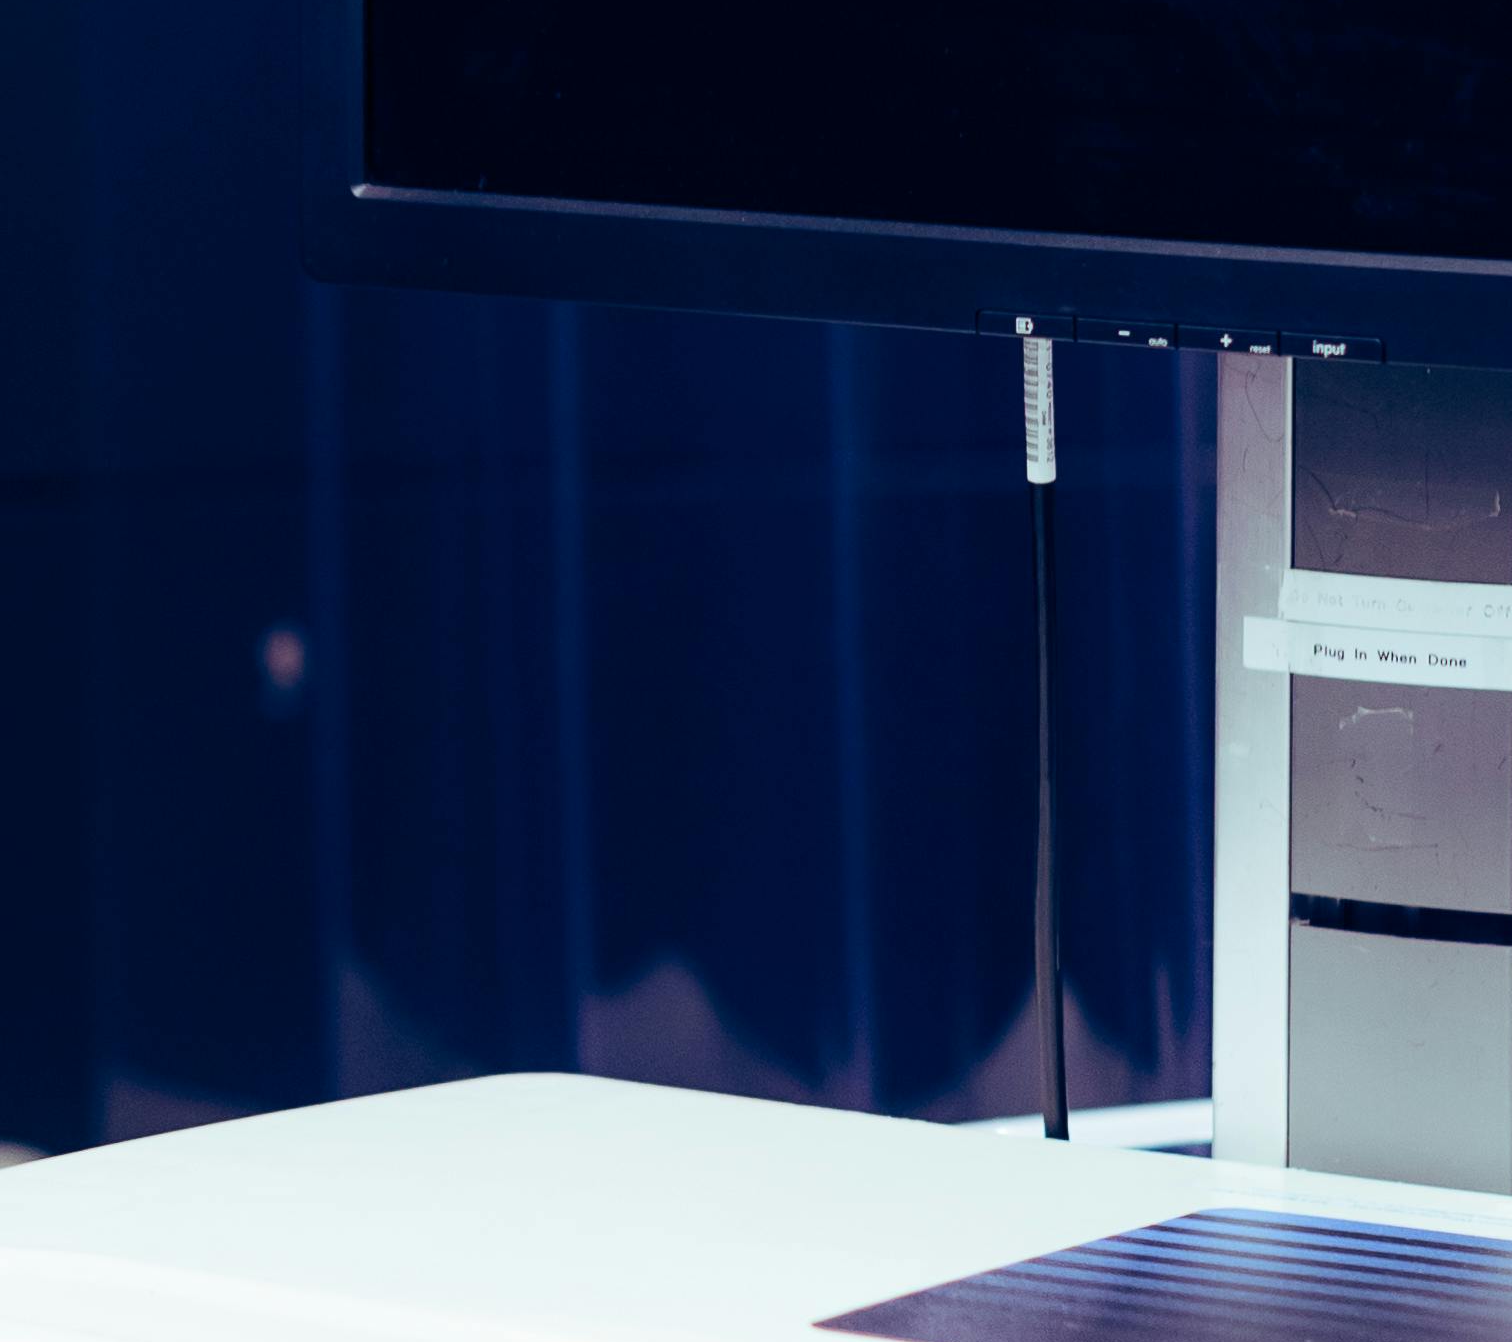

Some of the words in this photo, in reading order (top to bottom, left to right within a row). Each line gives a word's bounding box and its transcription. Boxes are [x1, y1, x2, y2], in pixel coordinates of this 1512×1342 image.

[1148, 336, 1168, 347] auto
[1312, 339, 1346, 359] input
[1249, 344, 1271, 355] reset
[1313, 644, 1345, 661] Plug
[1354, 648, 1368, 660] In
[1377, 649, 1417, 664] When
[1428, 654, 1467, 668] Done
